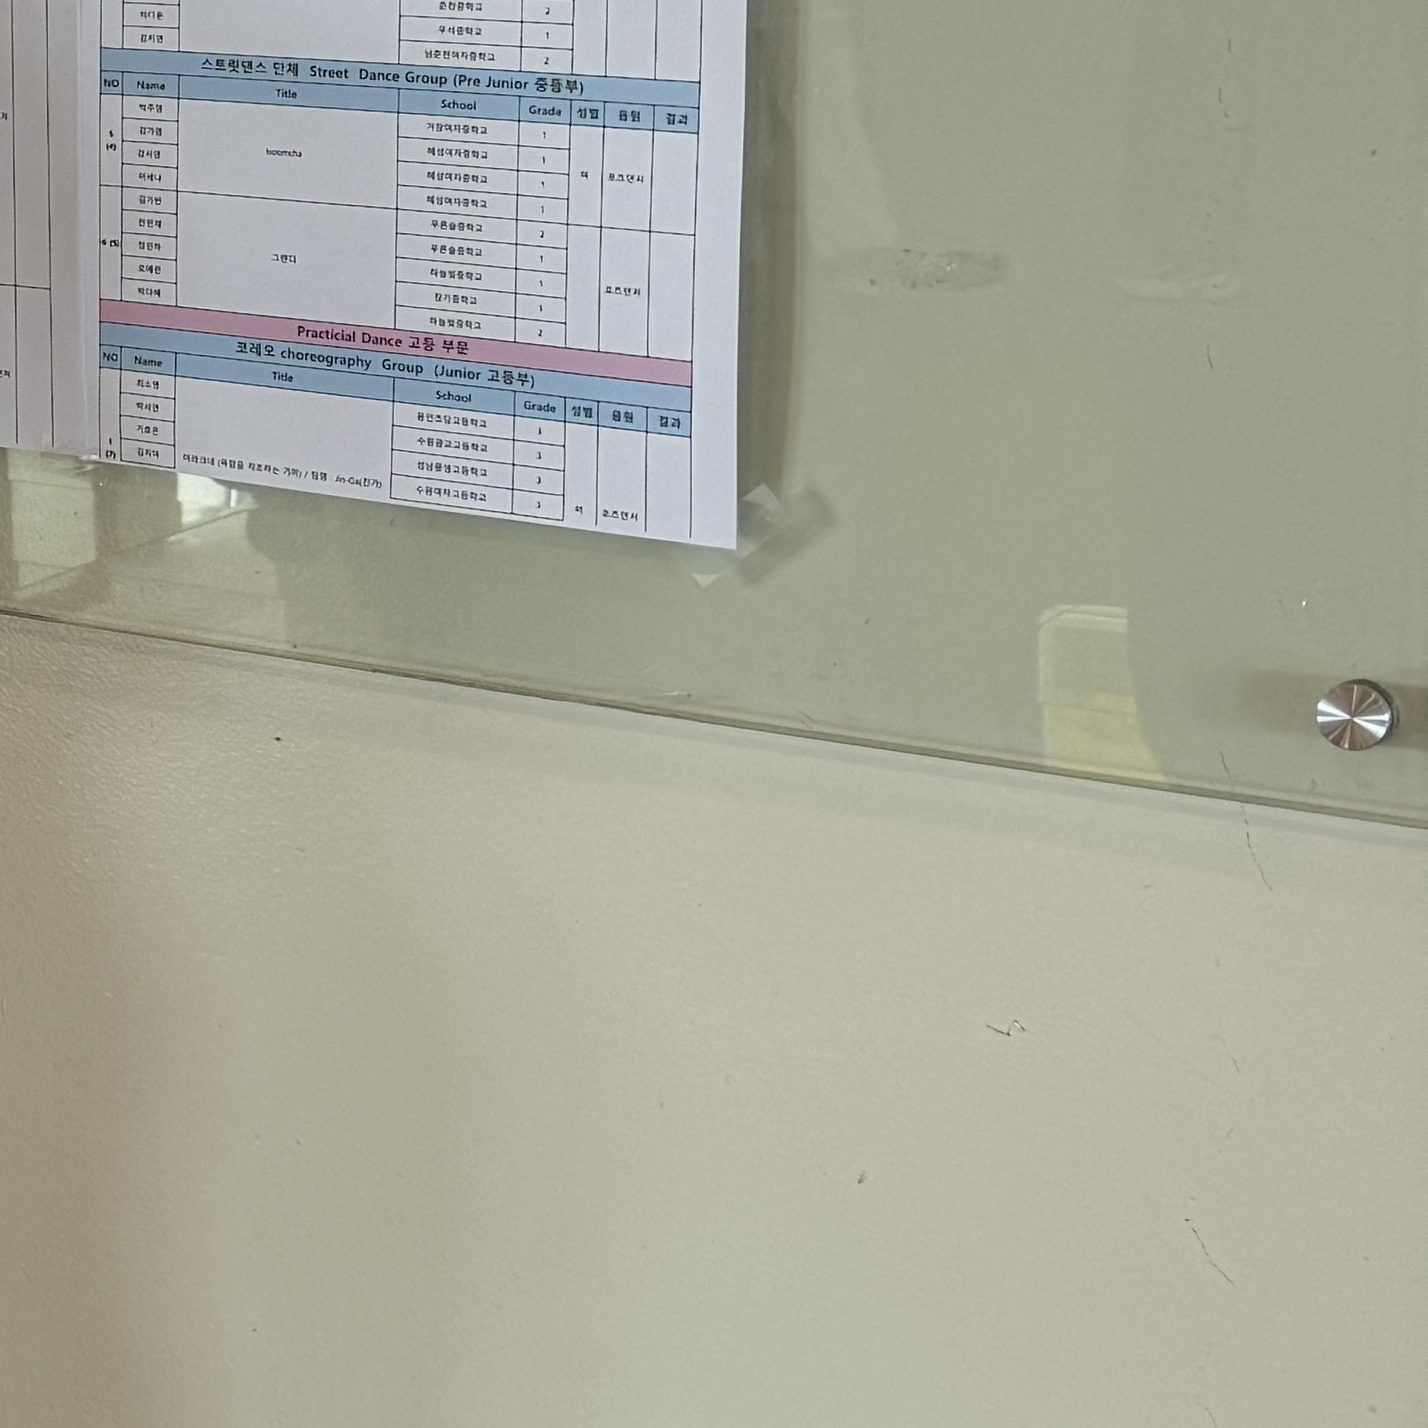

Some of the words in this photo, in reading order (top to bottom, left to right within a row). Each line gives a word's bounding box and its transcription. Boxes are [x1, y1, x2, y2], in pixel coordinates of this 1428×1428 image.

[201, 58, 267, 74] 스트릿댄스
[273, 62, 298, 76] 단체
[309, 66, 349, 79] Street
[359, 69, 399, 82] Dance
[405, 71, 447, 87] Group
[454, 74, 480, 90] (Pre
[485, 77, 528, 91] Junior
[534, 78, 584, 96] 중등부)
[104, 80, 119, 88] NO
[137, 82, 165, 90] Name
[276, 89, 297, 98] Title
[441, 99, 476, 111] School
[529, 106, 561, 116] Grade
[297, 326, 355, 344] Practicial
[361, 333, 402, 347] Dance
[409, 337, 435, 350] 고등
[443, 340, 469, 354] 부문
[103, 353, 118, 362] NO
[134, 356, 163, 368] Name
[273, 372, 293, 382] Title
[436, 390, 471, 402] School
[524, 401, 556, 414] Grade
[236, 342, 275, 358] 코레오
[281, 349, 371, 370] choreography
[382, 359, 423, 376] Group
[434, 364, 481, 381] (Junior
[487, 370, 535, 388] 고등부)
